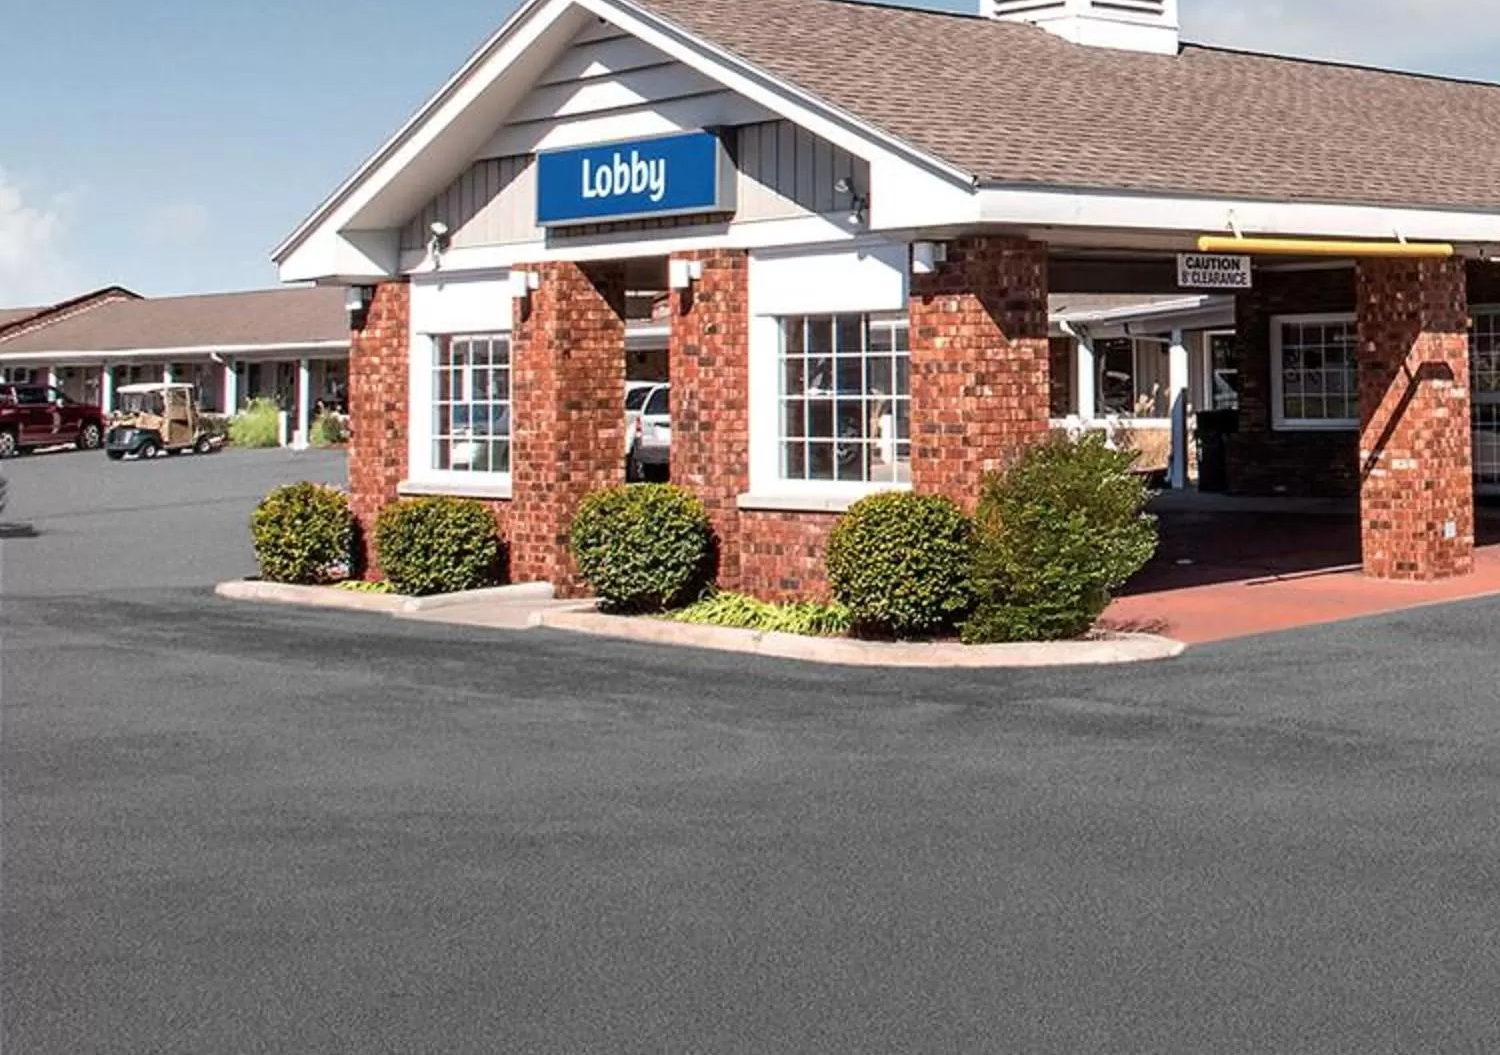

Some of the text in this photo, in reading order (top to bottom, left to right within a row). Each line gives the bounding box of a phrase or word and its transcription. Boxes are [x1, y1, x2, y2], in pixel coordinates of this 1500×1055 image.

[583, 150, 666, 201] Lobby
[1186, 257, 1241, 270] CAUTION
[1192, 271, 1247, 285] CLEARANCE
